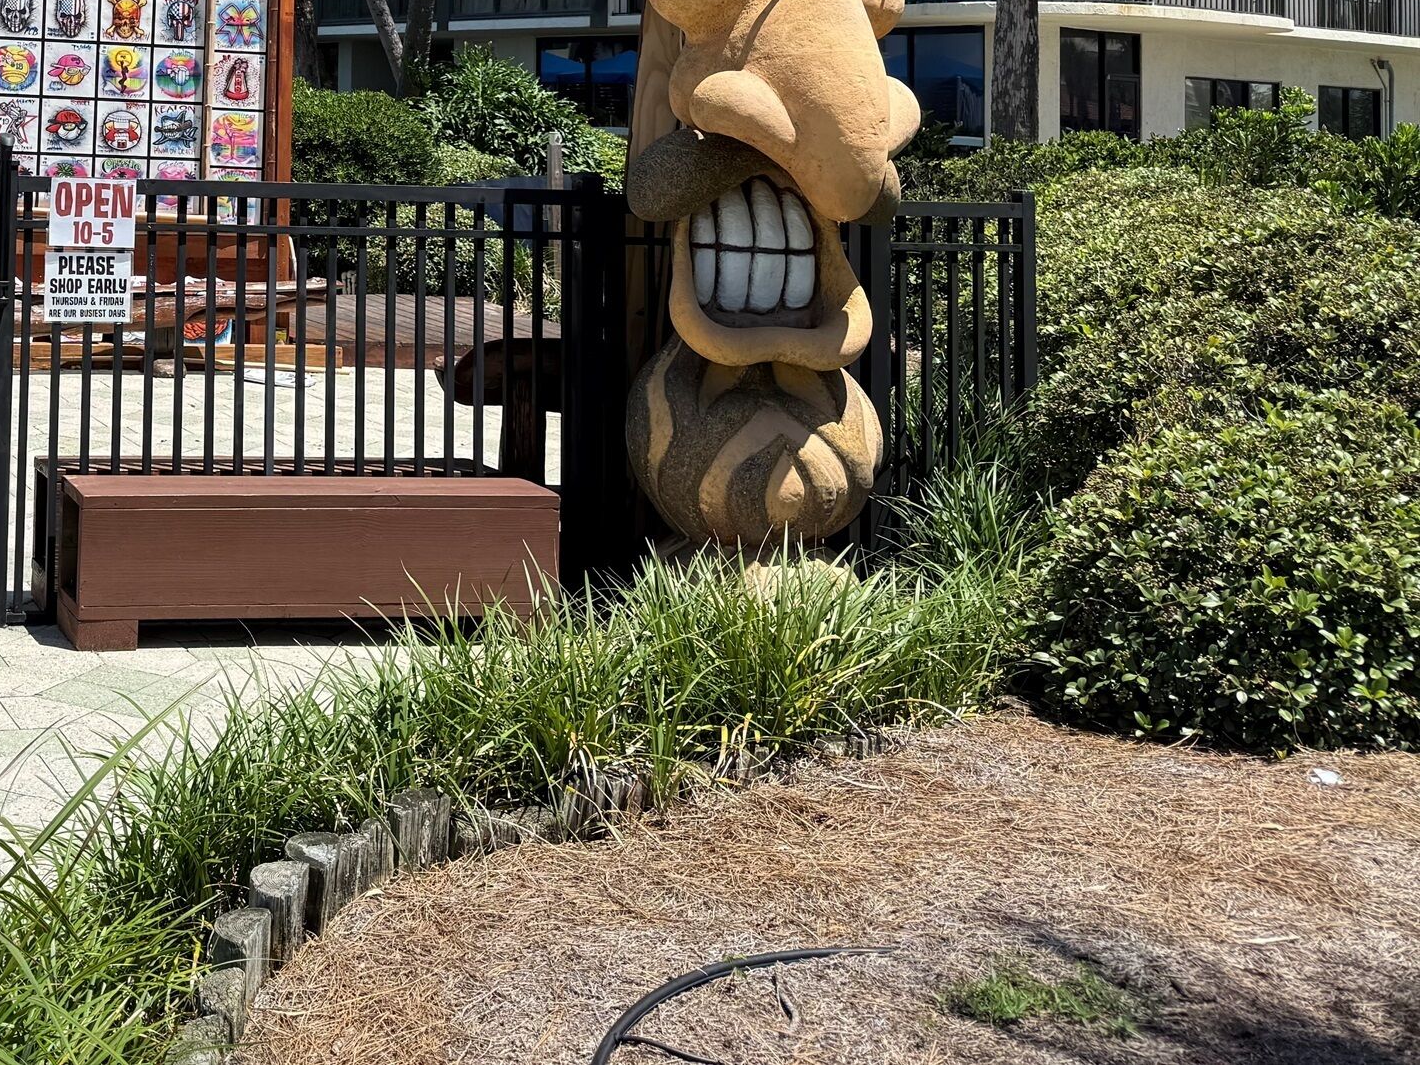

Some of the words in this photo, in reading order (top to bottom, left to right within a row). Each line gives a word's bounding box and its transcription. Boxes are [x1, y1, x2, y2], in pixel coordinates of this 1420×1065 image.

[154, 104, 196, 117] KEATON
[55, 182, 134, 219] OPEN
[73, 221, 114, 244] 10-5
[58, 256, 116, 275] PLEASE
[49, 278, 82, 294] SHOP
[87, 278, 127, 294] EARLY
[52, 296, 88, 306] THURSDAY
[90, 296, 96, 306] &
[99, 296, 124, 306] FRIDAY
[49, 309, 62, 318] ARE
[64, 309, 77, 318] OUR
[80, 309, 106, 318] BUSIEST
[108, 309, 126, 318] DAYS
